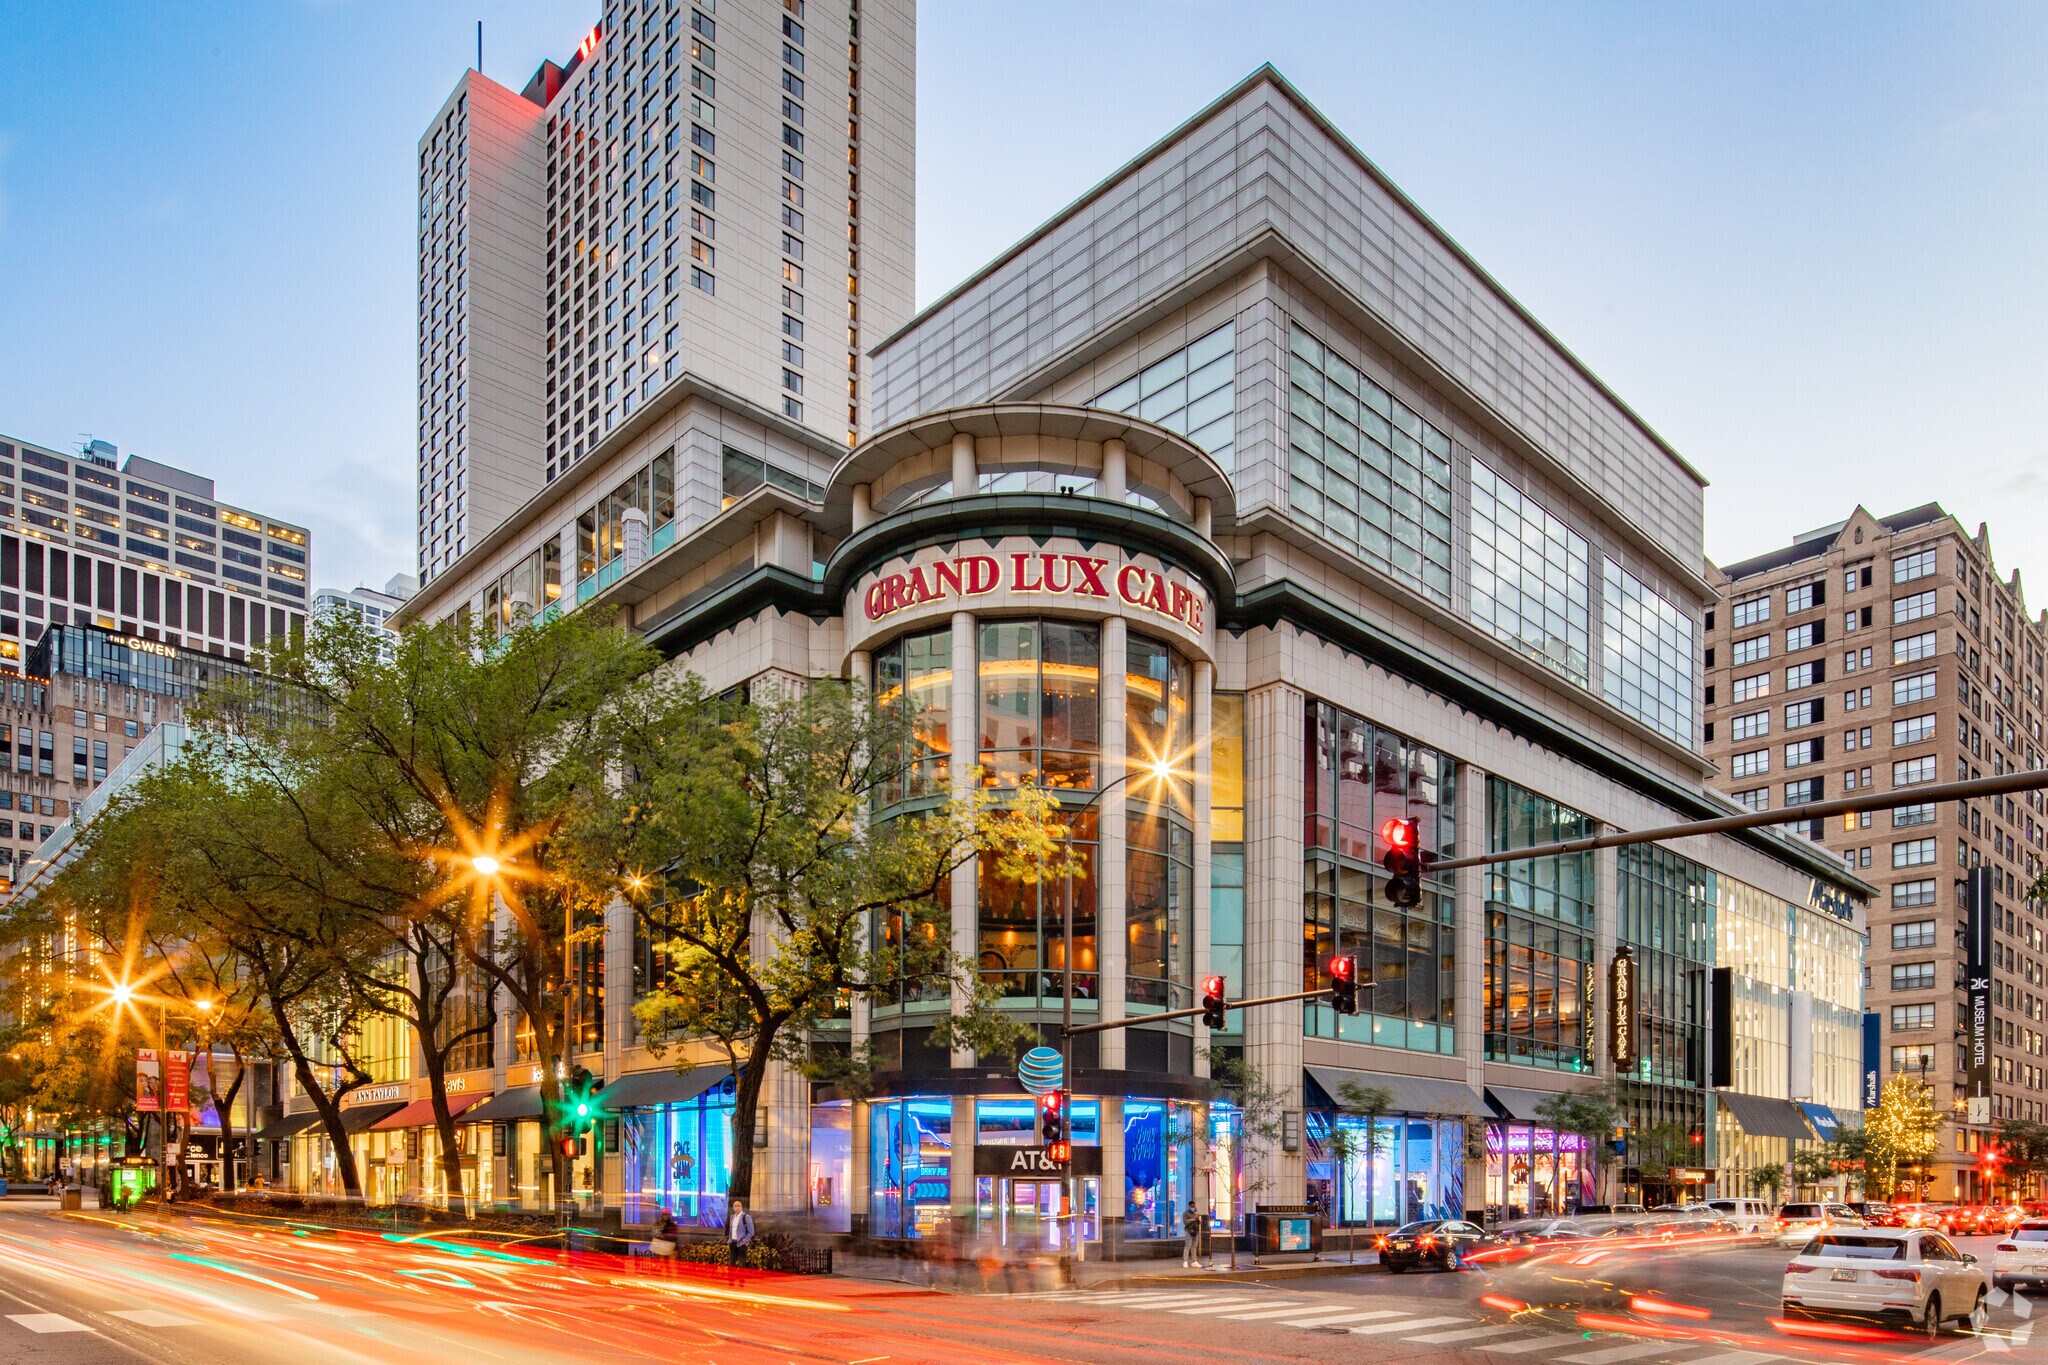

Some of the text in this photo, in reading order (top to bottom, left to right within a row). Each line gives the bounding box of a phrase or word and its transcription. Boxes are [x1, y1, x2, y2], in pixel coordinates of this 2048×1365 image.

[864, 553, 1205, 635] GRAND LUX CAFE
[109, 635, 176, 659] THE GWEN
[1616, 959, 1628, 1060] GRAND LUX CAFE
[1974, 995, 1985, 1069] MUSEUM HOTEL
[355, 1086, 399, 1102] ANN TAYLOR
[1866, 1070, 1877, 1107] Marshalls
